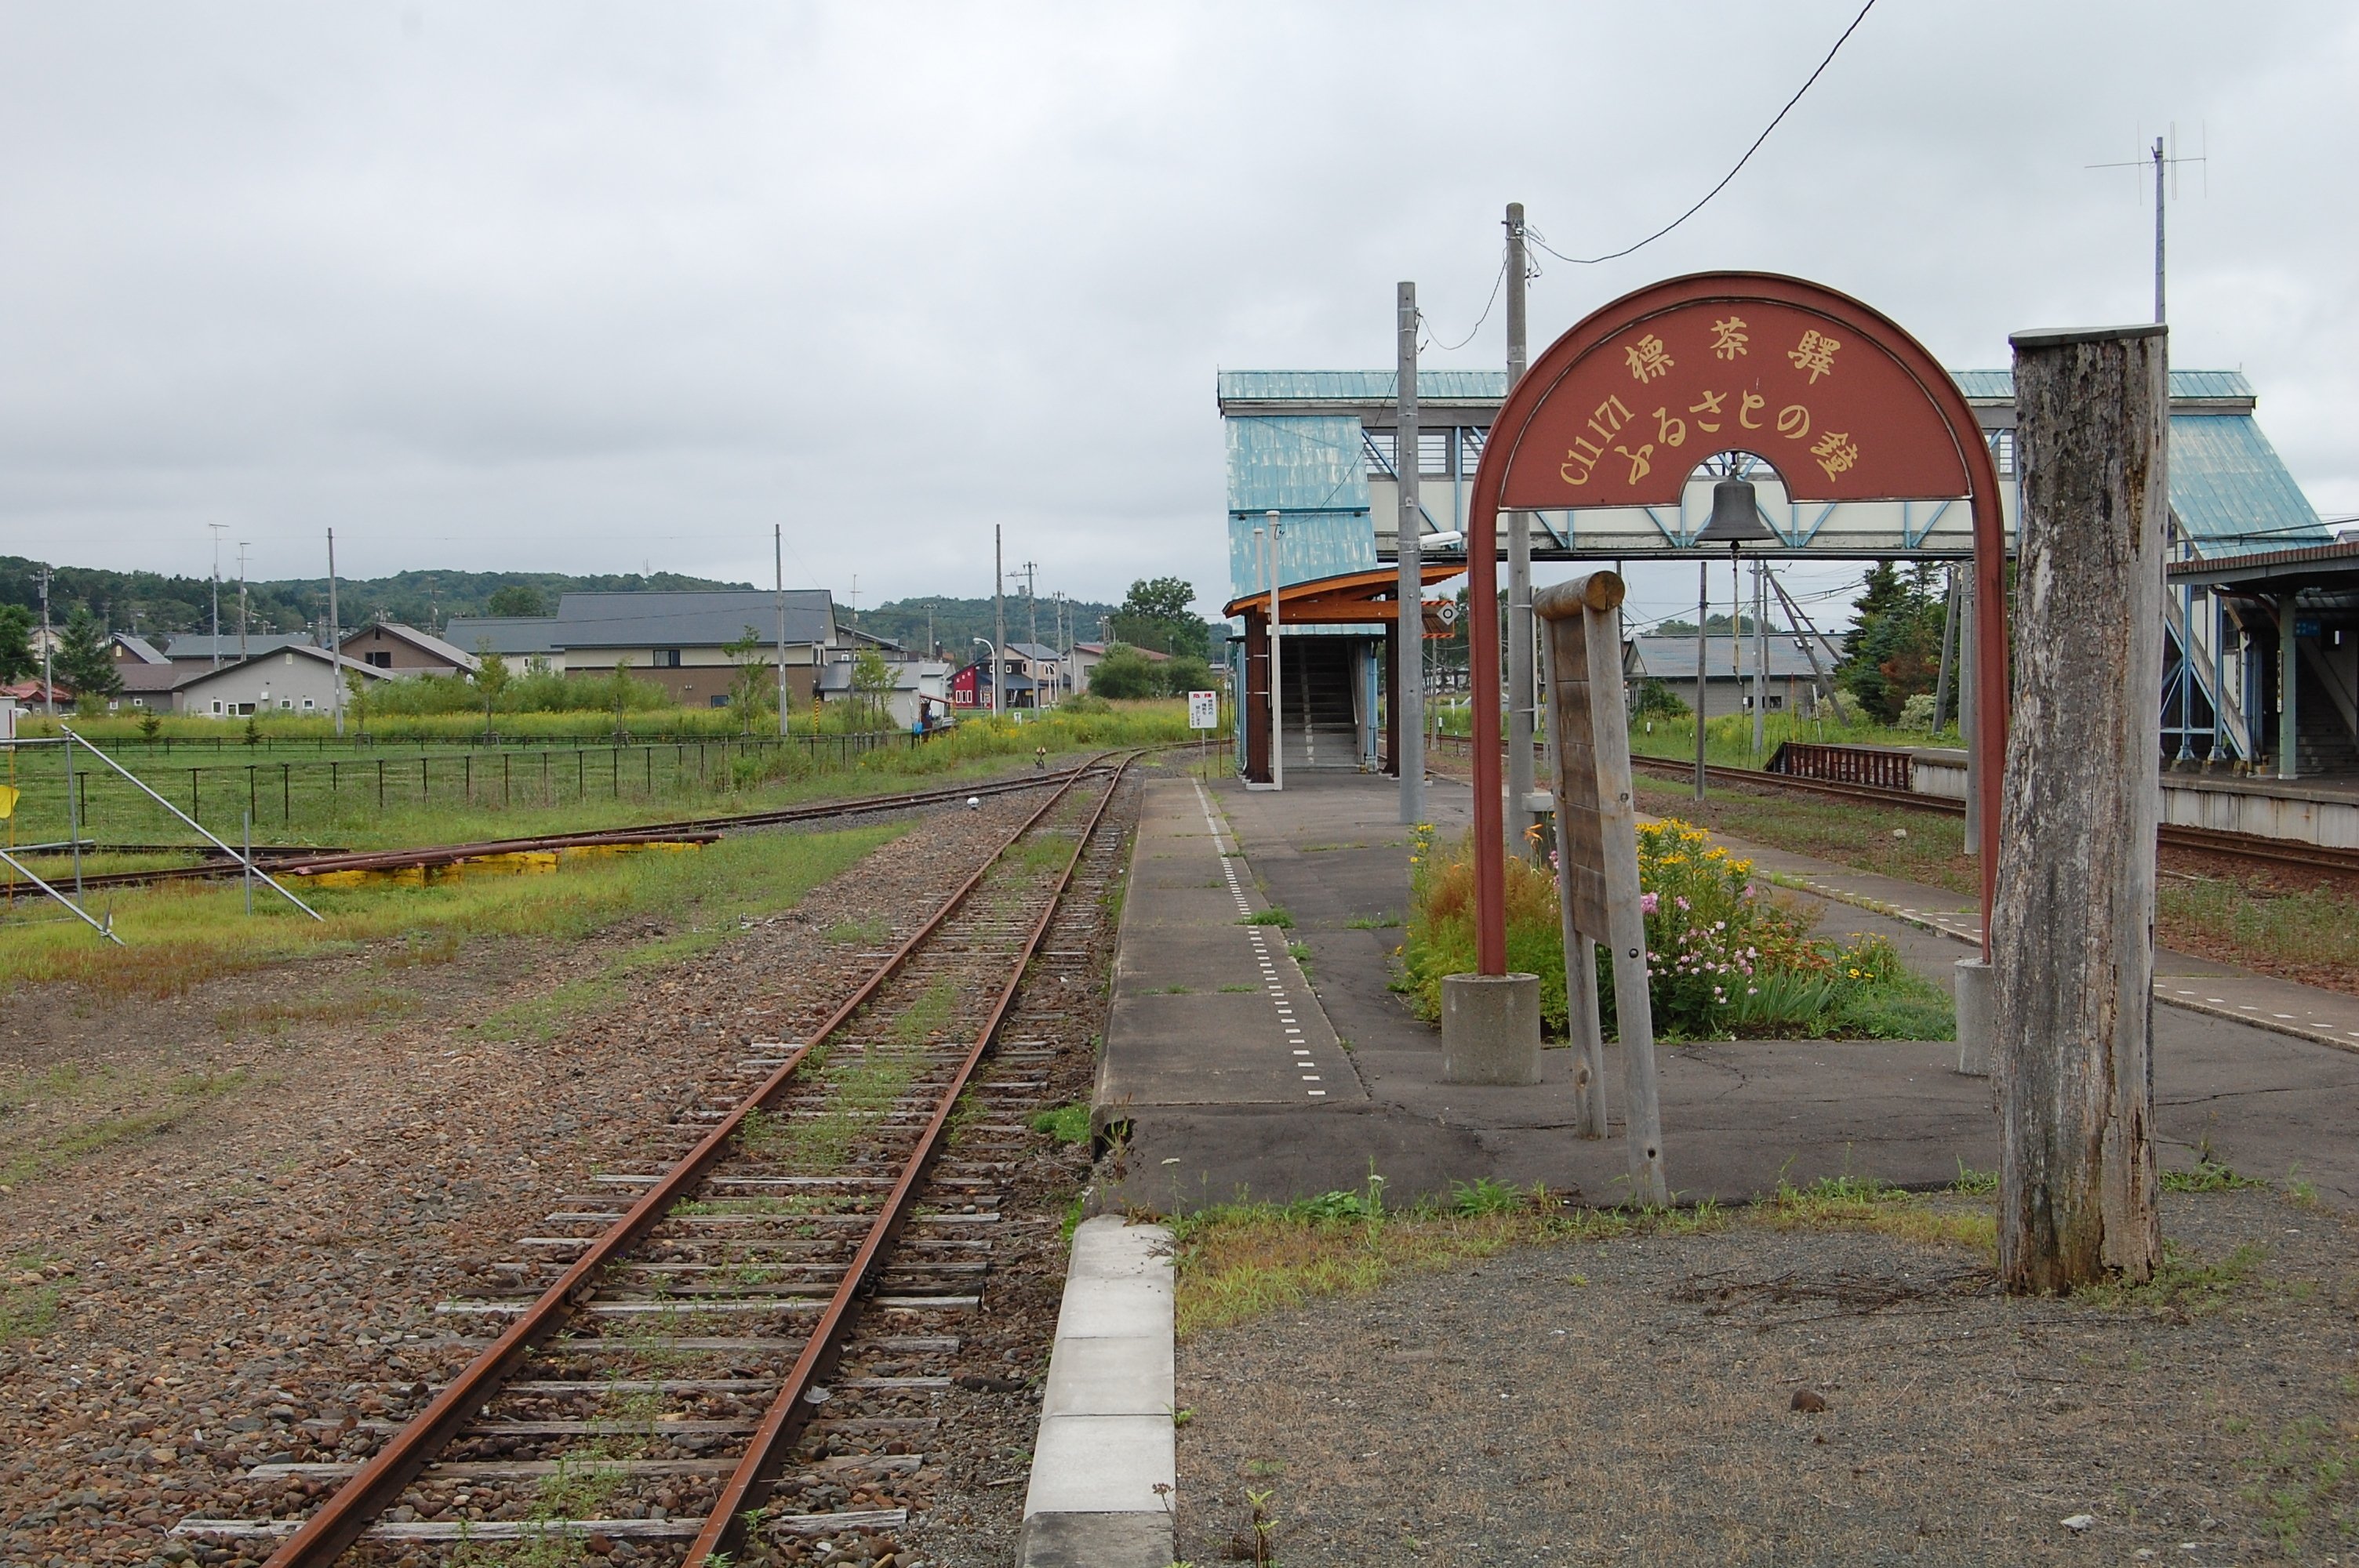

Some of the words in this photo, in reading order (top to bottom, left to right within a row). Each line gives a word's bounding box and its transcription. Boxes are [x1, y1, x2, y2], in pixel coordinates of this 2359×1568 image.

[1613, 389, 1858, 485] ふるさとの鐘
